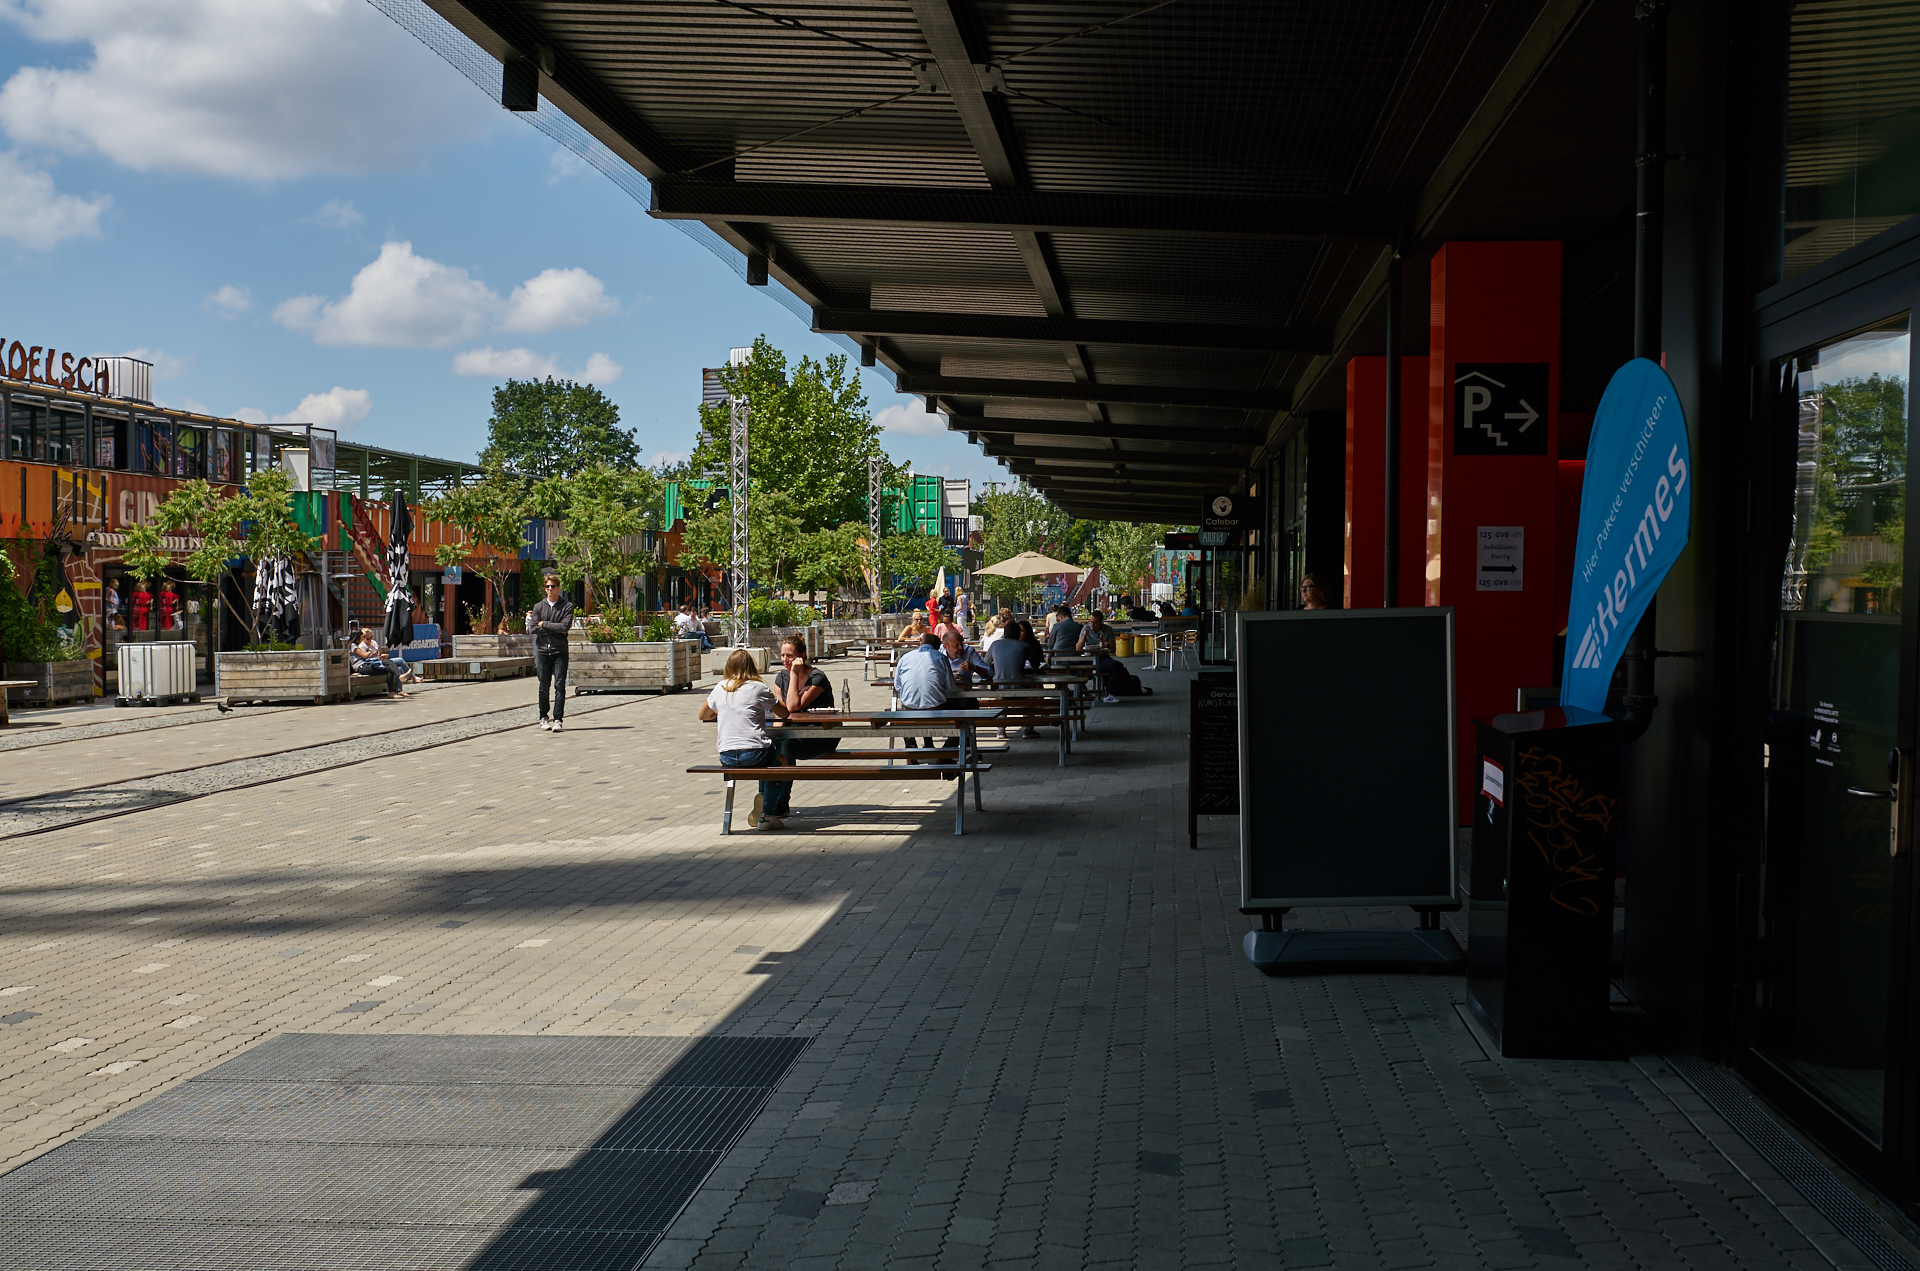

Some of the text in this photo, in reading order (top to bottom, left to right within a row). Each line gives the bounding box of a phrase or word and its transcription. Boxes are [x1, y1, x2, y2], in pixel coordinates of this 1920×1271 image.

[1463, 385, 1492, 428] P
[1583, 396, 1667, 583] Hier Pakete verschicken.
[1205, 517, 1239, 526] Cafebar
[1490, 553, 1511, 561] Party
[1597, 443, 1687, 648] Hermes
